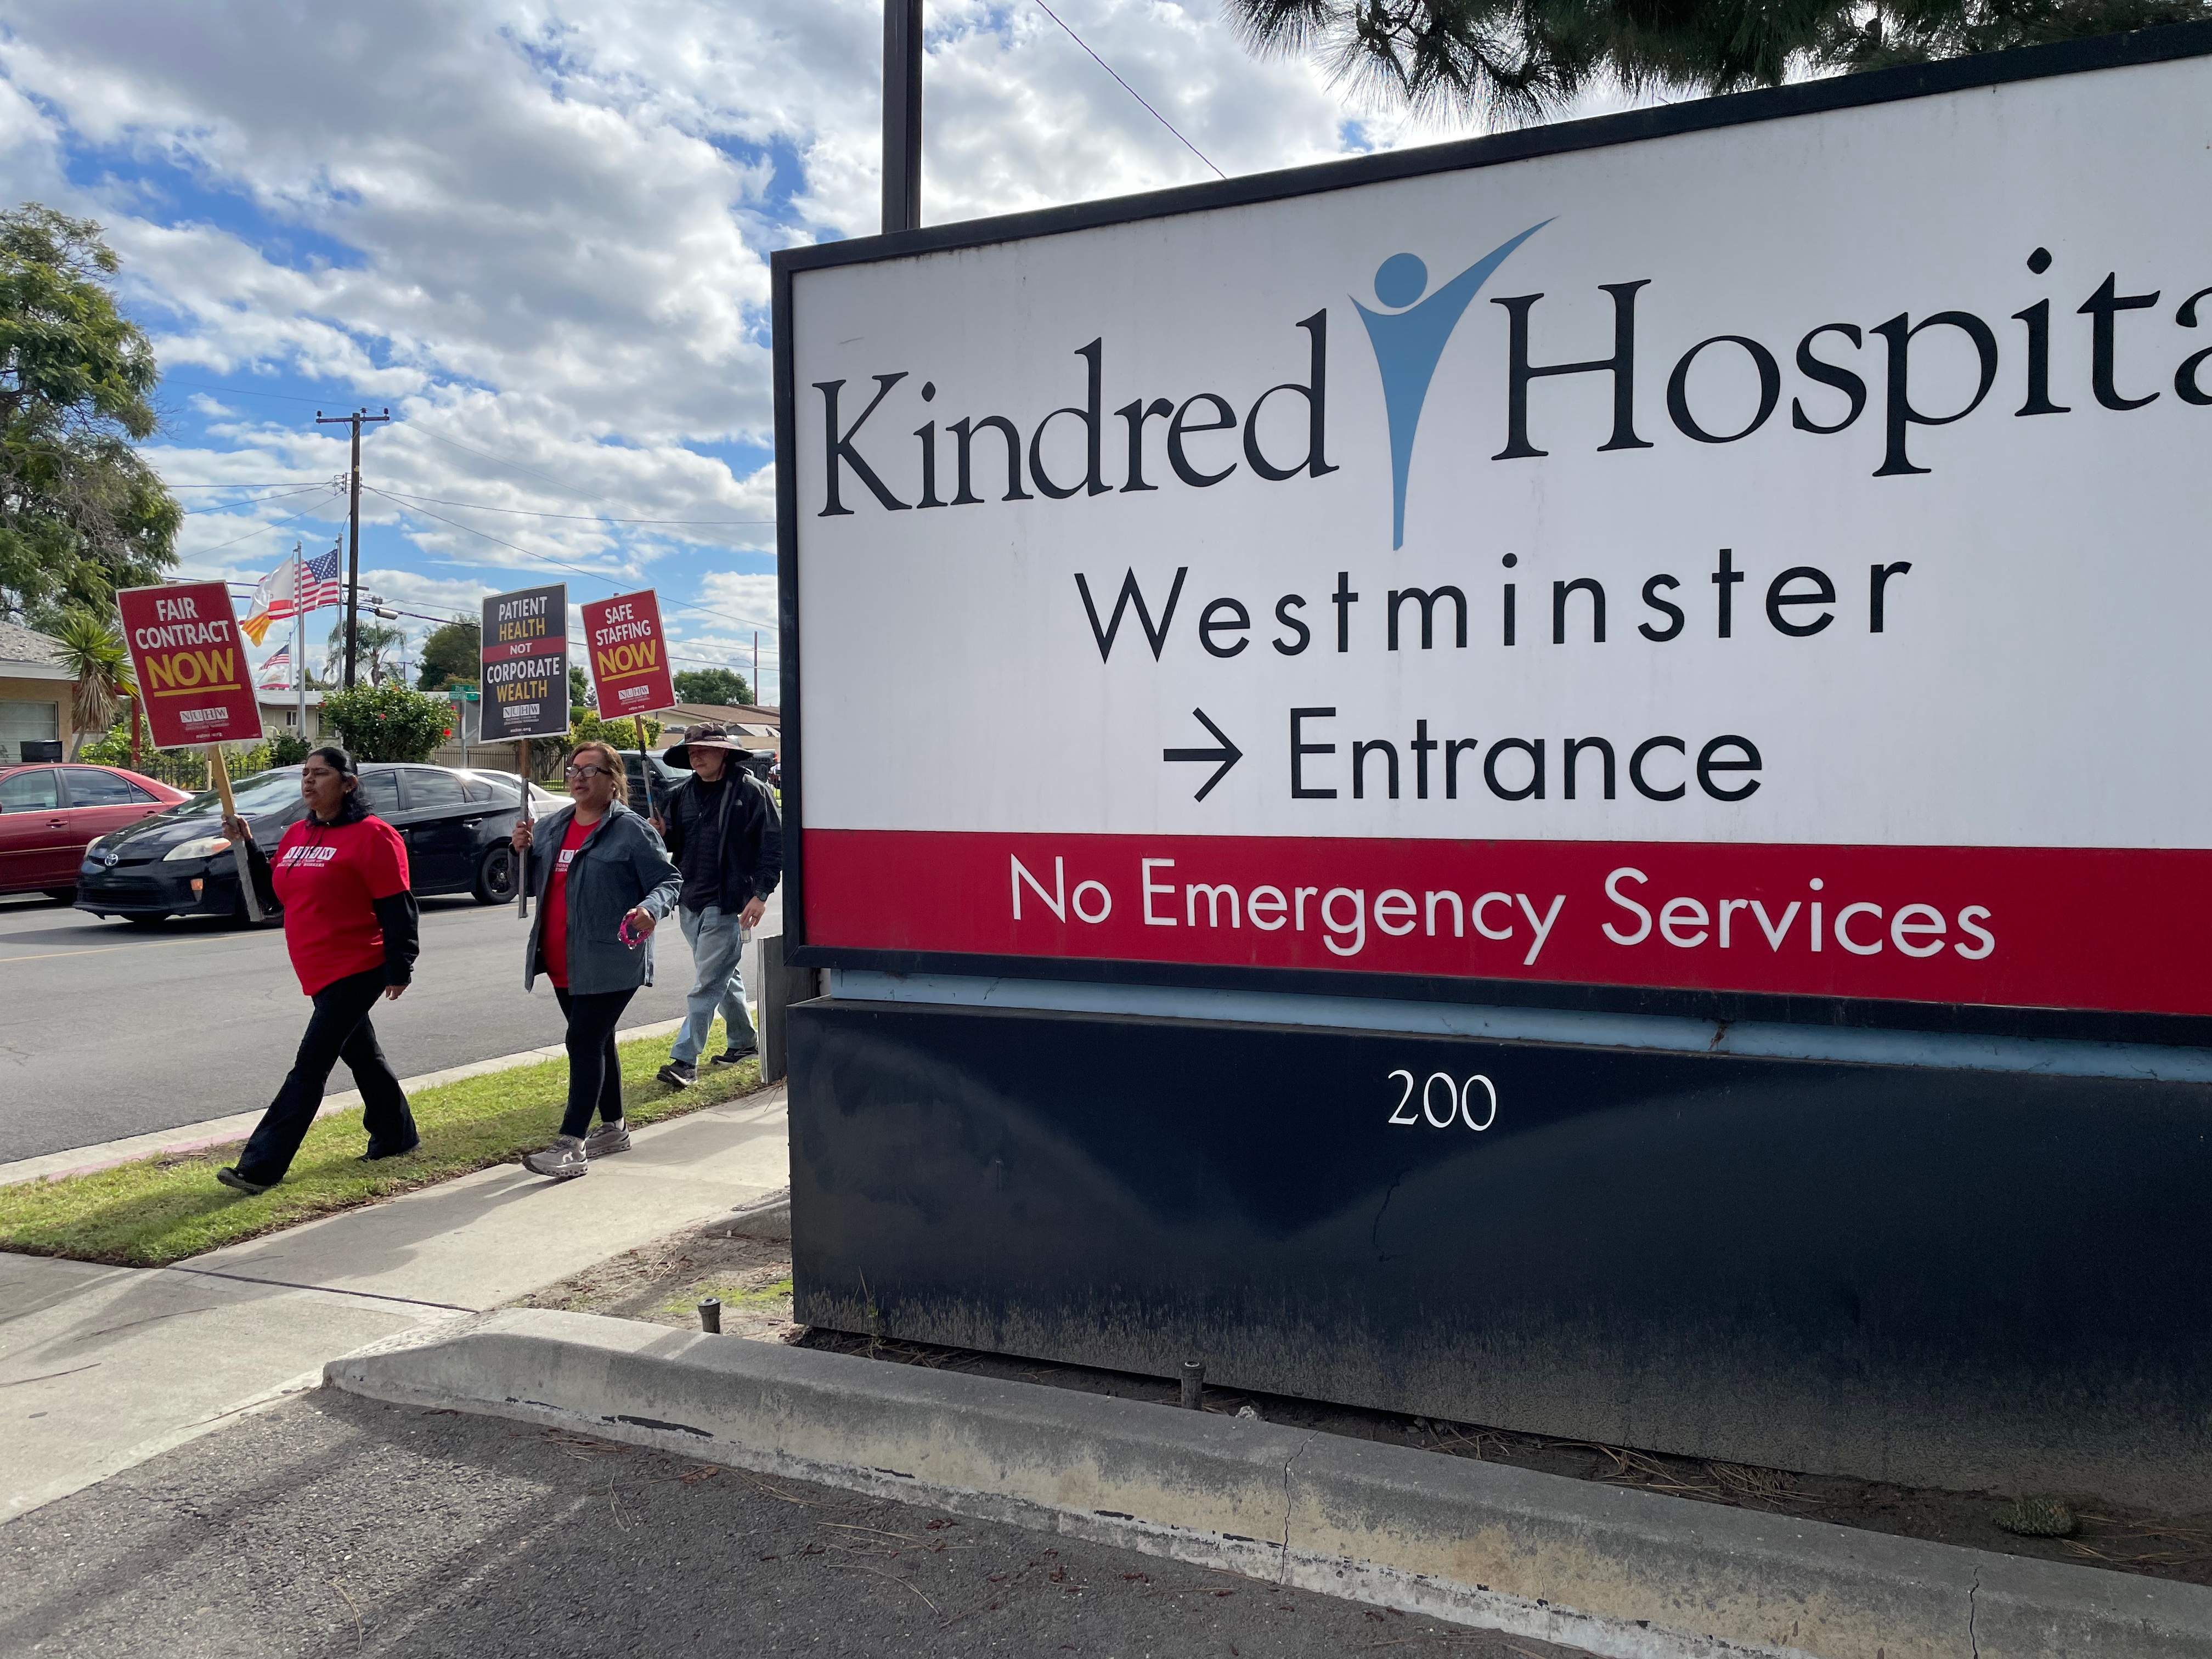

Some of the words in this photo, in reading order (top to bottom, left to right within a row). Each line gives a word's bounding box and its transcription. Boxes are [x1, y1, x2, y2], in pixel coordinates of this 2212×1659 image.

[812, 308, 1340, 517] Kindred
[156, 597, 199, 622] FAIR
[498, 596, 548, 621] PATIENT
[605, 603, 634, 624] SAFE
[1073, 548, 1913, 664] Westminster
[136, 620, 230, 650] CONTRACT
[499, 617, 546, 642] HEALTH
[595, 619, 652, 646] STAFFING
[510, 642, 532, 656] NOT
[597, 639, 657, 676] NOW
[145, 648, 234, 689] NOW
[486, 657, 560, 685] CORPORATE
[496, 679, 548, 703] WEALTH
[619, 686, 648, 698] NUHW
[180, 708, 227, 722] NUHW
[504, 704, 539, 716] NUHW
[1290, 707, 1762, 802] Entrance
[1011, 853, 1113, 924] No
[1142, 857, 1566, 966] Emergency
[1601, 867, 1995, 960] Services
[1387, 1069, 1497, 1131] 200
